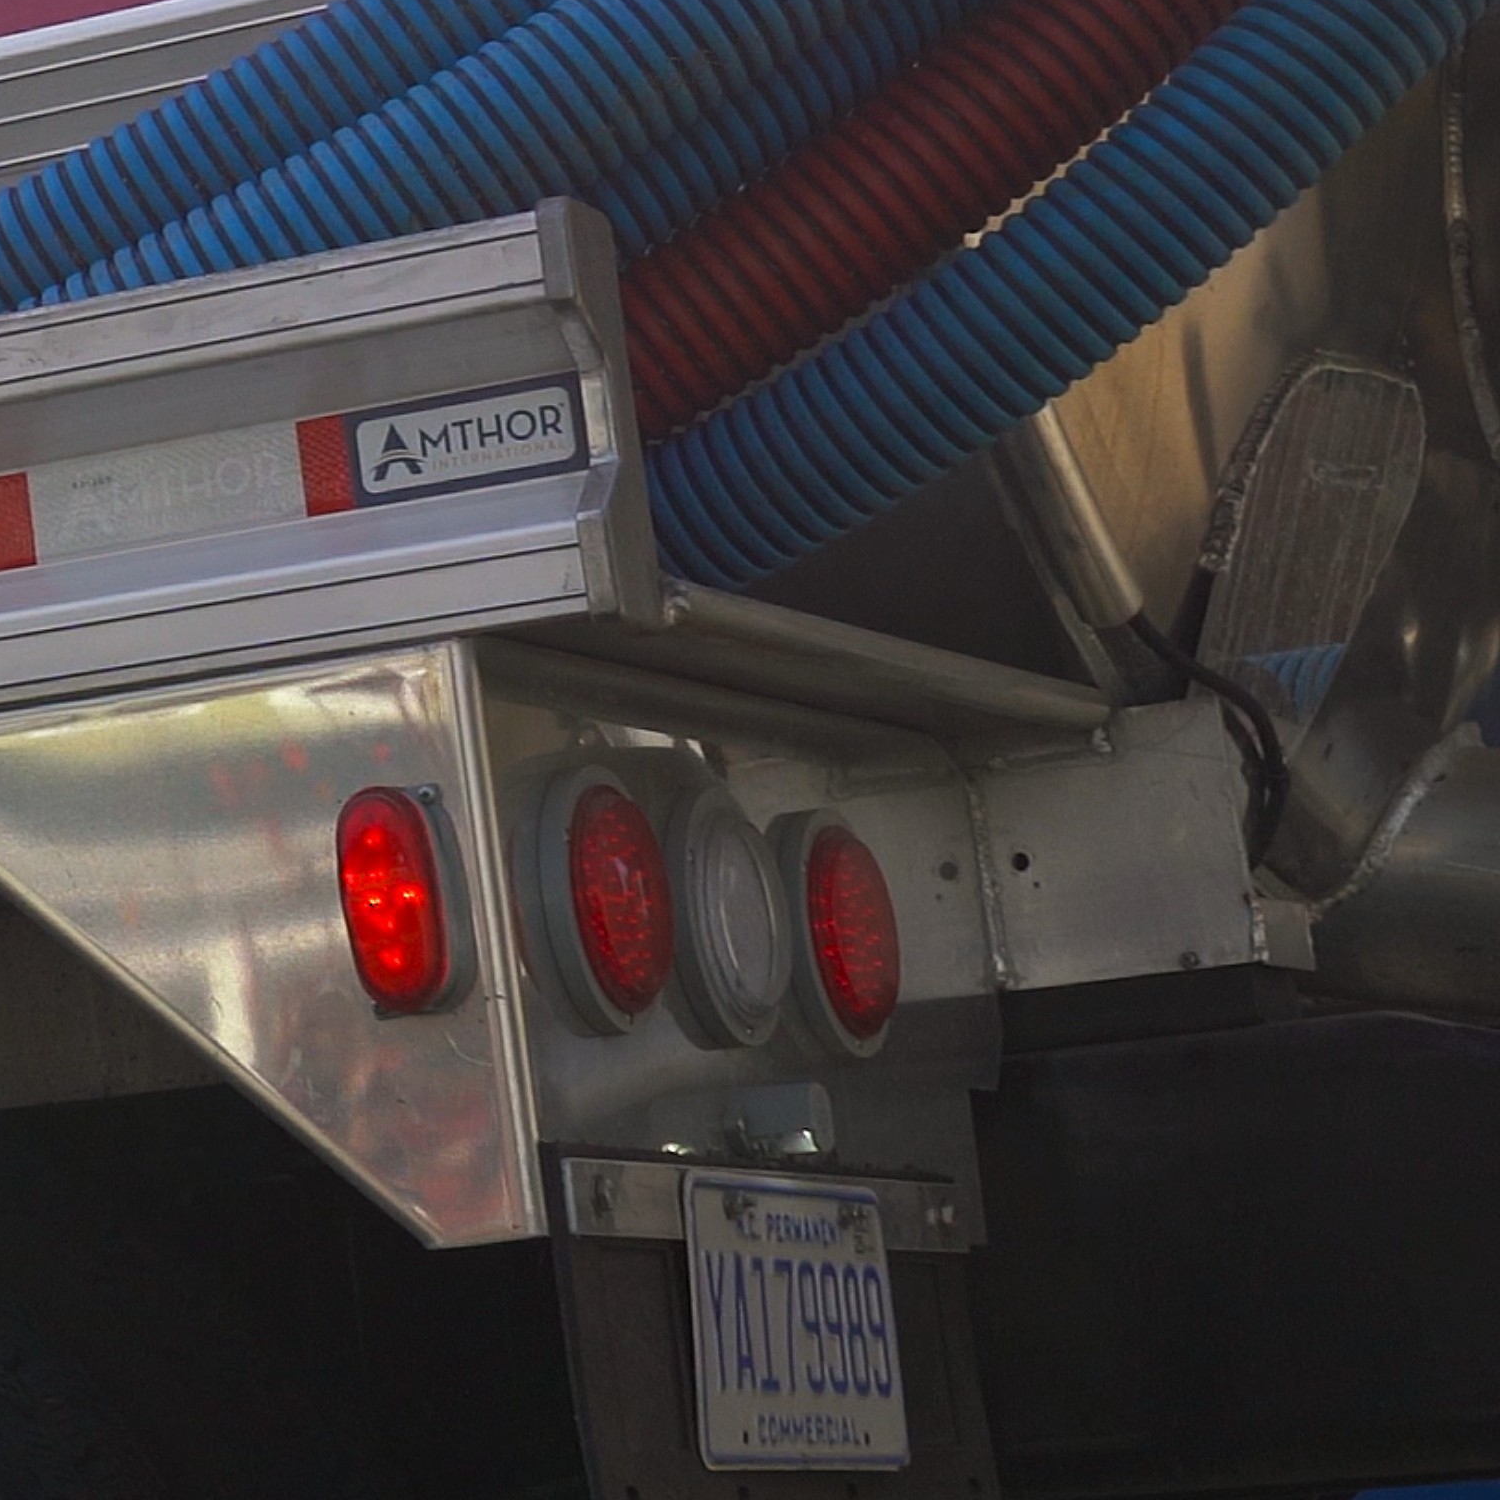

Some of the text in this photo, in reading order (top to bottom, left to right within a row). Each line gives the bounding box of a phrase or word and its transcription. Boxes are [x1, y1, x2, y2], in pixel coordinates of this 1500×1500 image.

[371, 403, 565, 483] AMTHOR
[705, 1250, 893, 1397] YA179989
[756, 1413, 862, 1447] COMMERCIAL
